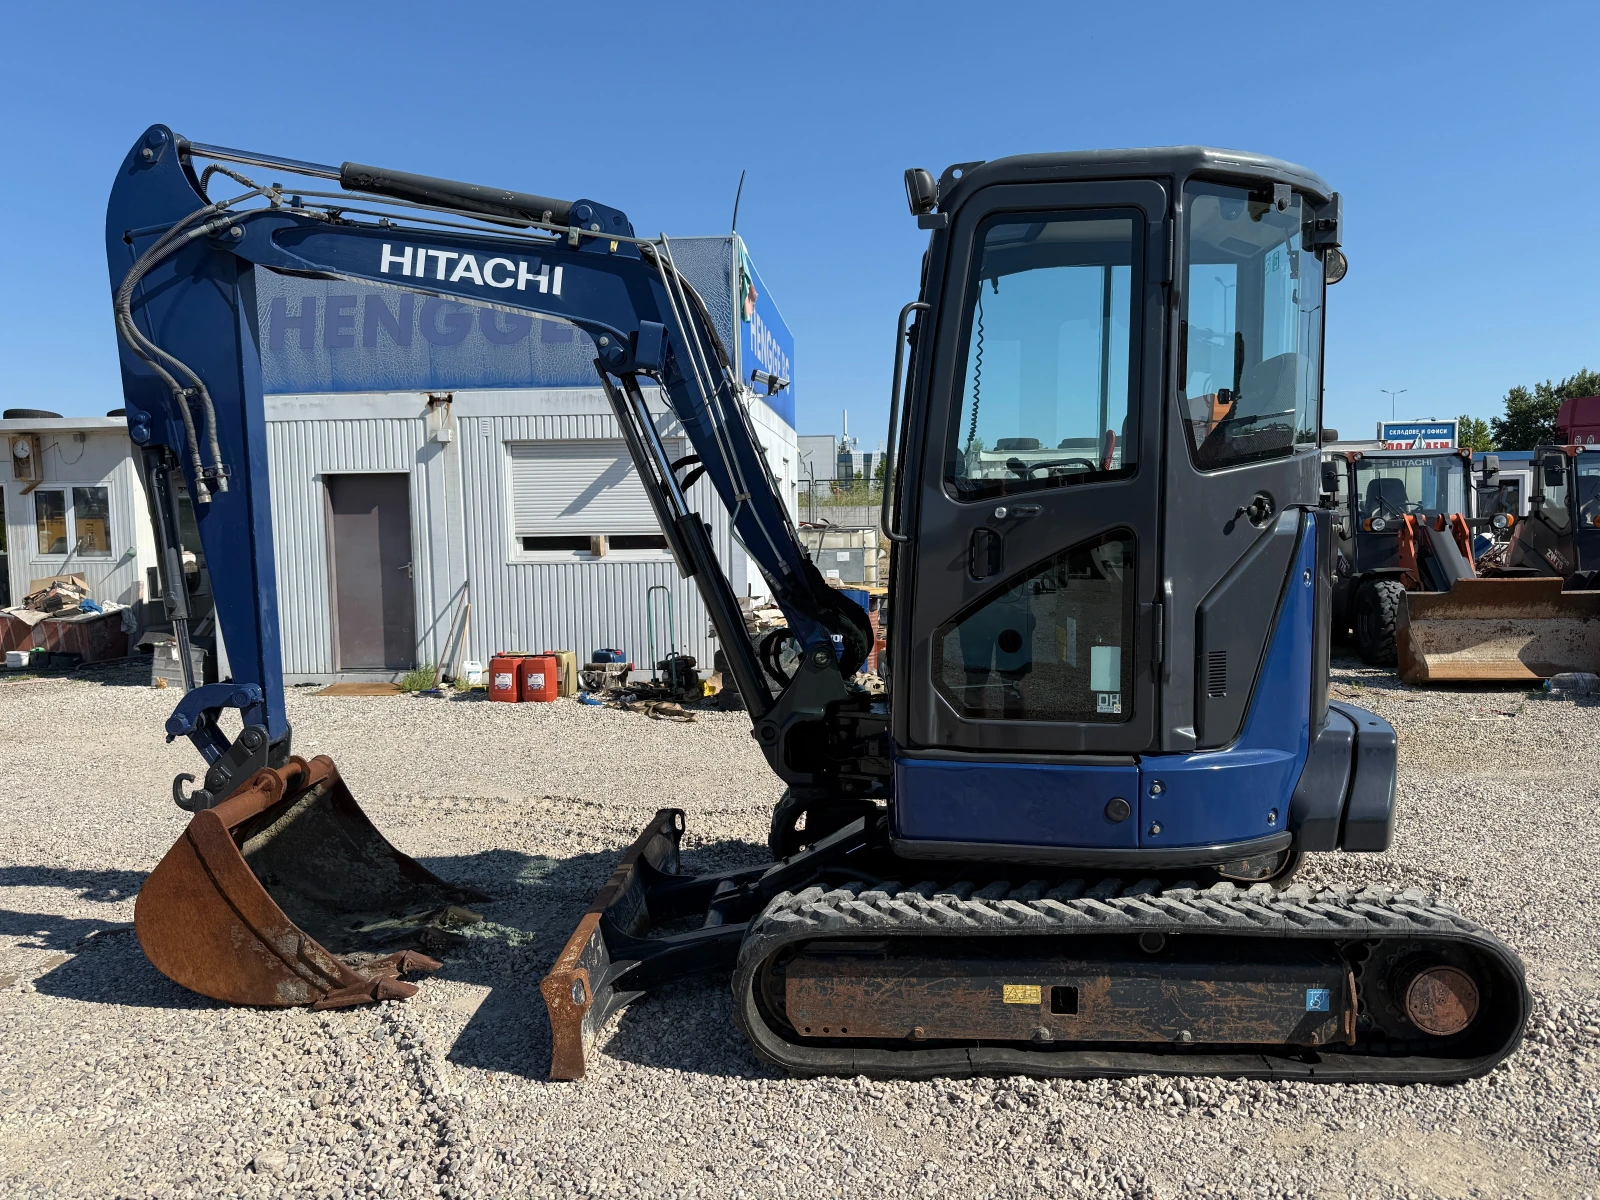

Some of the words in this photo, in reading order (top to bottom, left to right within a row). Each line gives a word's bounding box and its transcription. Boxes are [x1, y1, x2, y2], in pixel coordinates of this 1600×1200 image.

[380, 243, 564, 295] HITACHI
[1389, 428, 1420, 436] СКЛАДОВЕ
[1391, 459, 1433, 467] HITACHI
